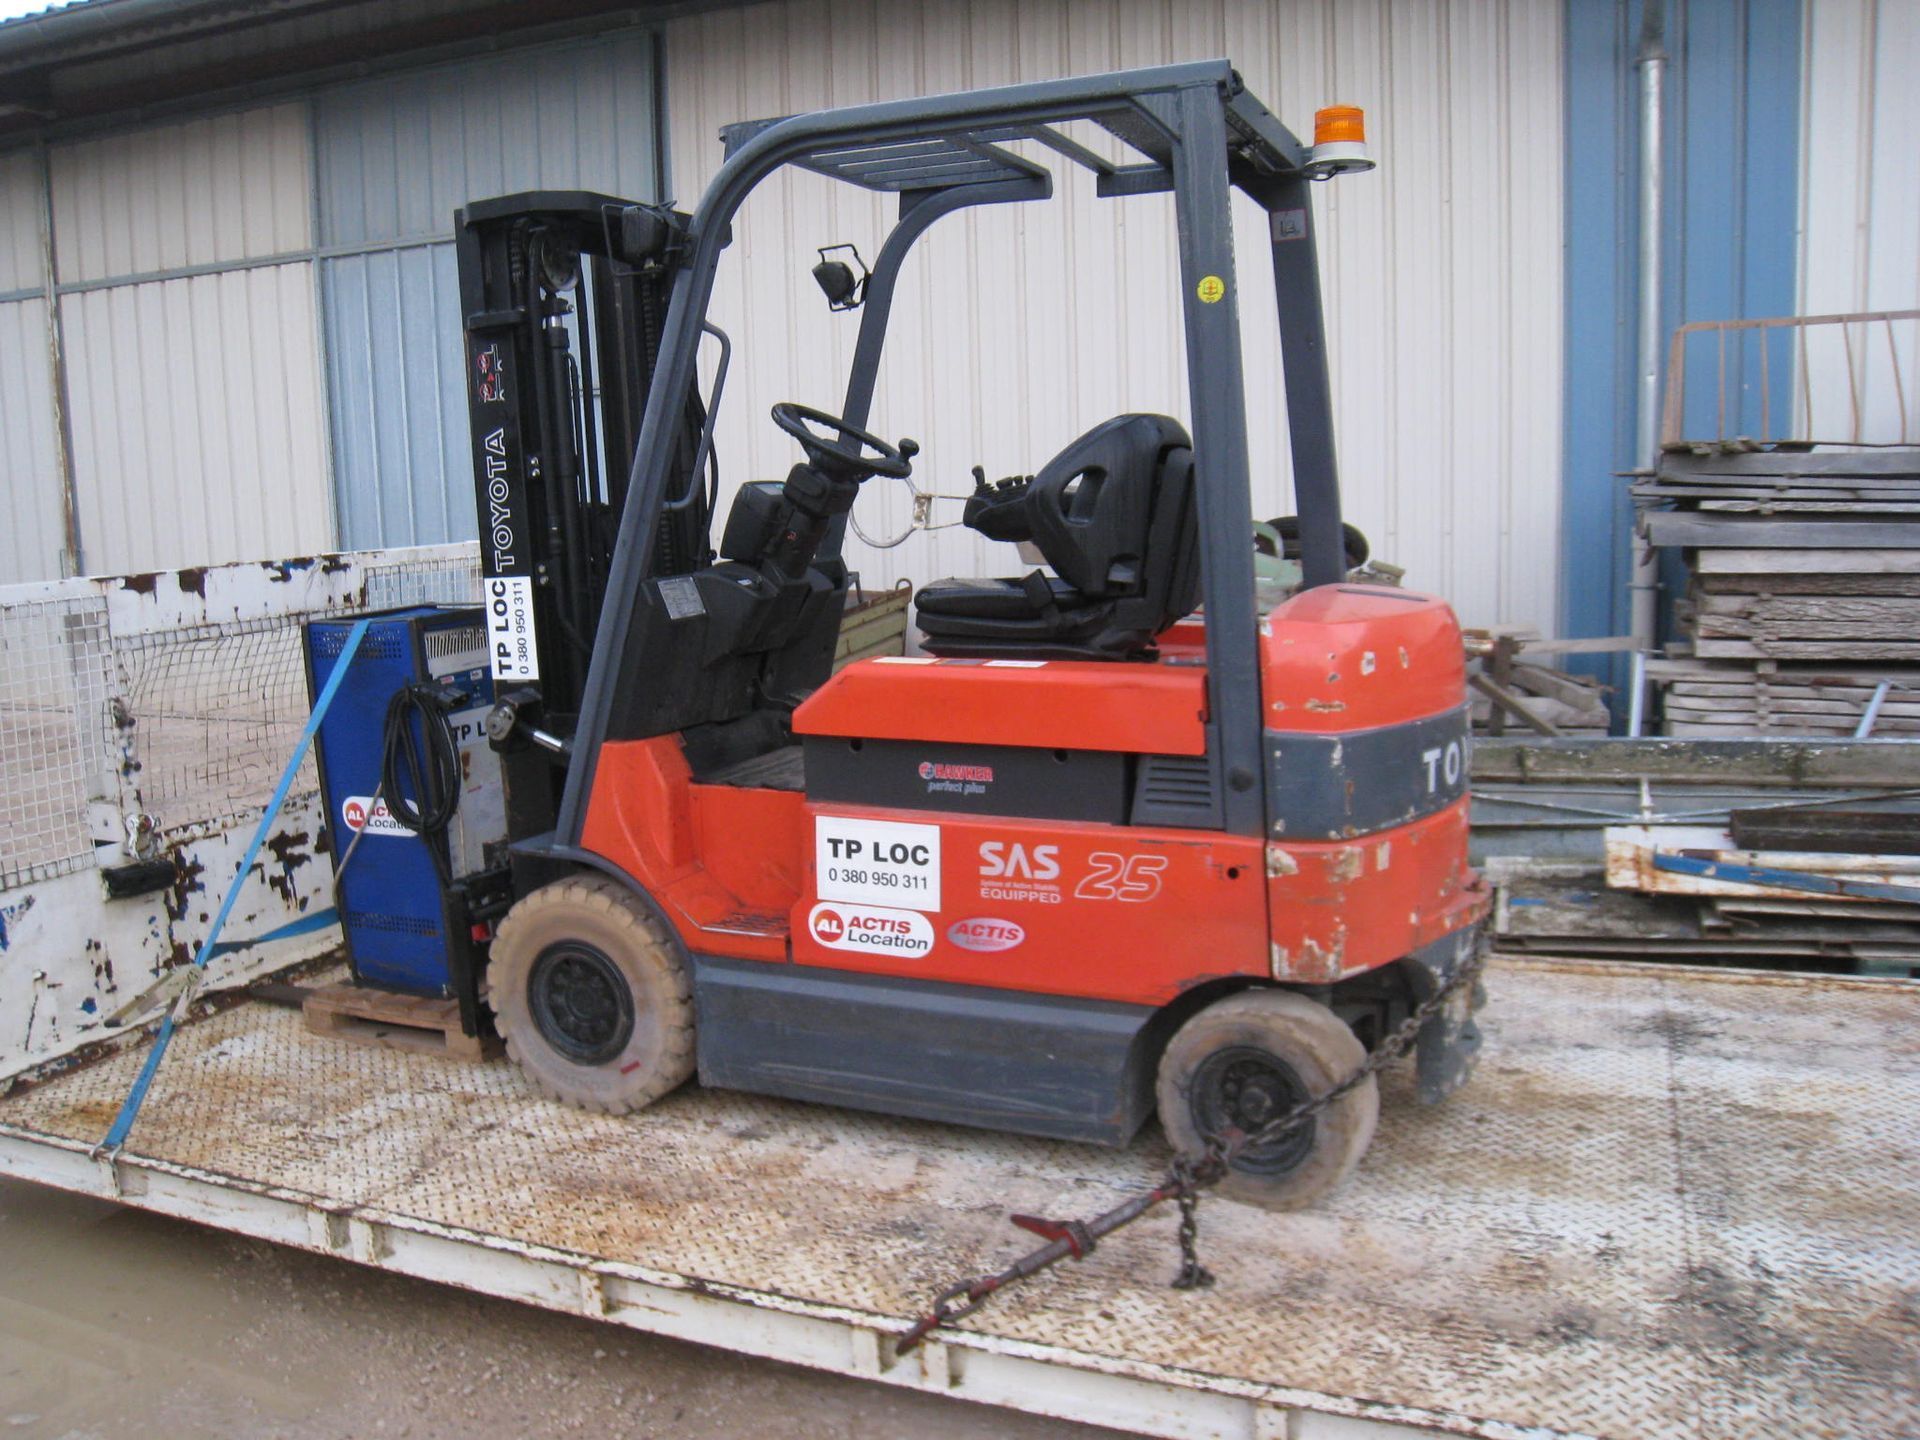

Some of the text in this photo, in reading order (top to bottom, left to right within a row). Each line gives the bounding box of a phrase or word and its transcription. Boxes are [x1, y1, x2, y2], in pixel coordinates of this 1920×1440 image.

[485, 428, 515, 573] TOYOTA
[492, 580, 512, 675] TP LOC
[512, 582, 530, 675] 0 380 950 311
[345, 809, 364, 821] AL
[827, 838, 930, 866] TP LOC
[828, 867, 928, 890] 0 380 950 311
[979, 841, 1169, 902] SAS 25
[980, 887, 1061, 904] EQUIPPED
[816, 919, 842, 934] AL
[848, 916, 912, 934] ACTIS
[954, 923, 1020, 940] ACTIS
[848, 929, 928, 950] Location
